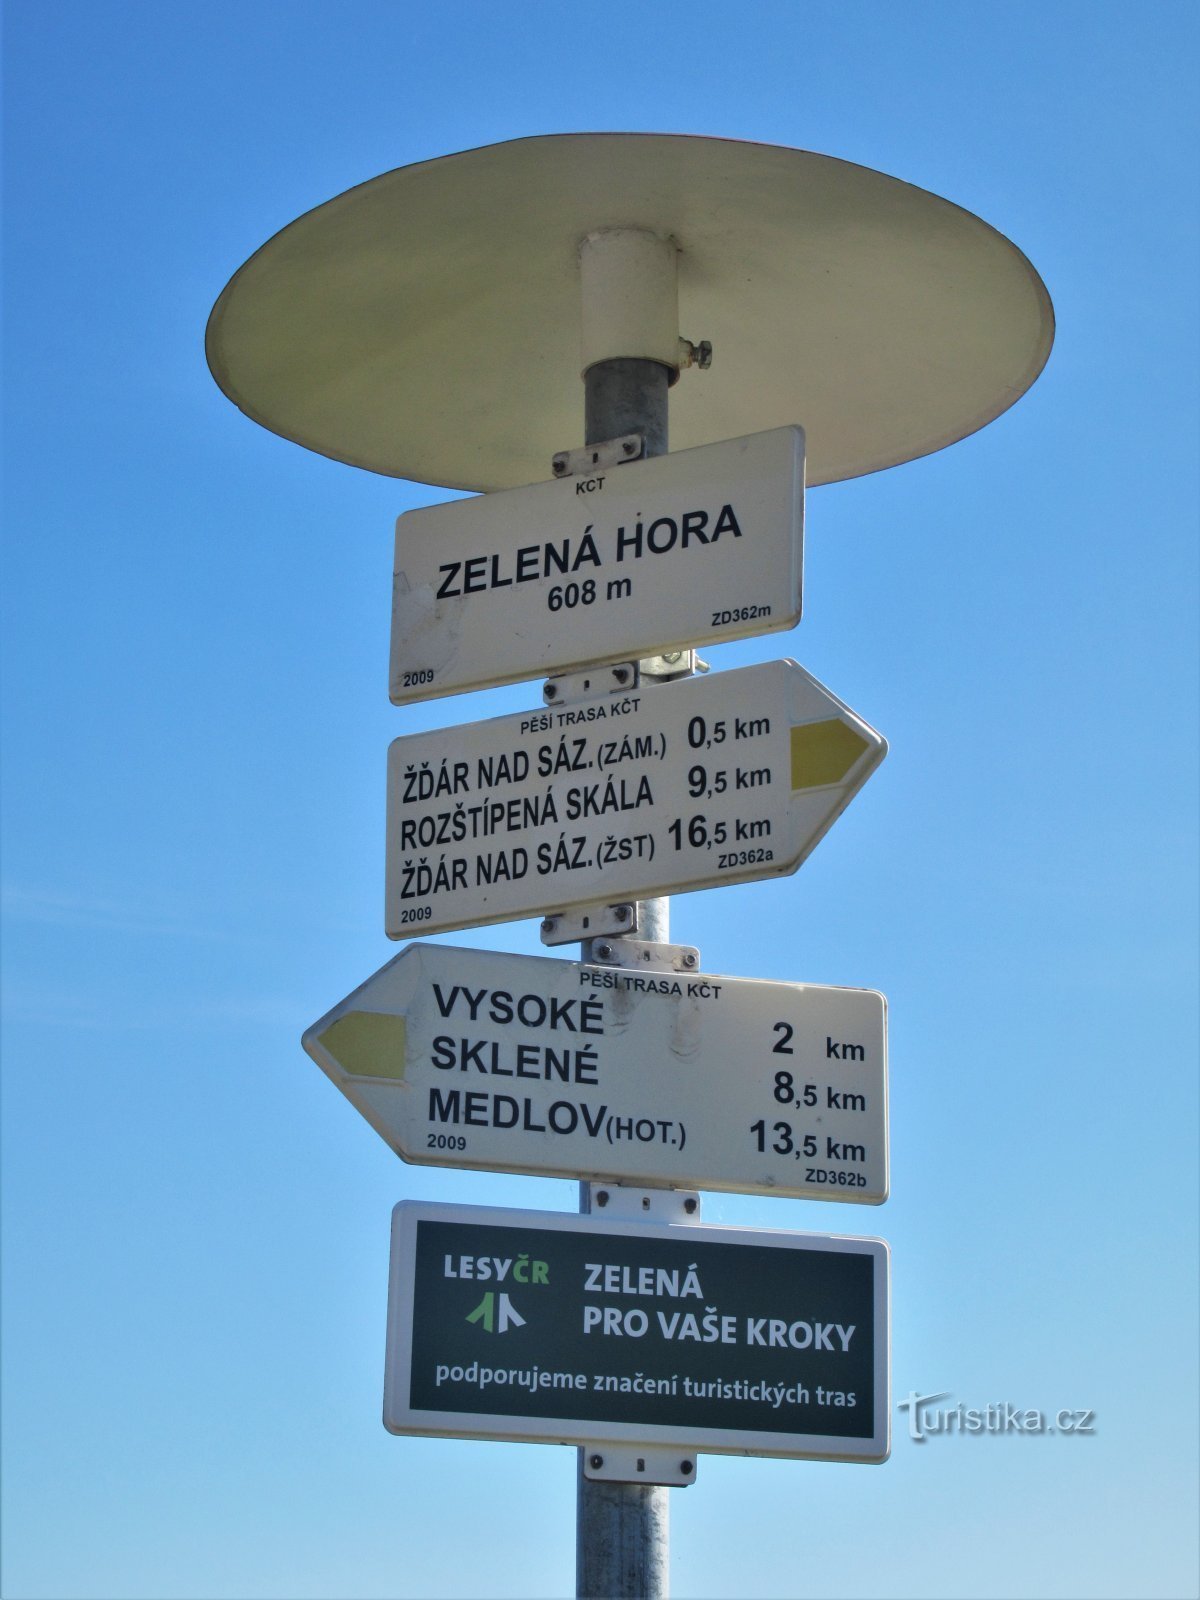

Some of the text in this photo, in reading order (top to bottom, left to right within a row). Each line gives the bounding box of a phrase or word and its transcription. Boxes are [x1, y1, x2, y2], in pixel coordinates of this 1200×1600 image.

[436, 504, 742, 599] ZELENÁ HORA
[547, 577, 632, 612] 608 m
[711, 603, 771, 627] ZD362m
[403, 670, 434, 687] 2009
[521, 698, 640, 734] PĚŠÍ TRASA KČT
[403, 758, 470, 803] ŽĎÁR
[478, 750, 529, 789] NAD
[688, 716, 726, 749] 0,5
[735, 718, 770, 740] km
[401, 765, 771, 851] ROZŠTÍPENÁ SKÁLA 9,5 km
[401, 854, 468, 899] ŽĎÁR
[476, 847, 528, 886] NAD
[668, 815, 727, 850] 16,5
[736, 819, 771, 841] km
[718, 849, 773, 869] ZD362a
[401, 906, 432, 923] 2009
[580, 971, 722, 999] PĚŠÍ TRASA KČT
[432, 983, 865, 1061] VYSOKÉ 2 km
[431, 1036, 866, 1111] SKLENÉ 8,5 km
[427, 1134, 466, 1150] 2009
[750, 1120, 817, 1160] 13,5
[827, 1137, 865, 1162] km
[805, 1168, 867, 1187] ZD362b
[584, 1263, 703, 1300] ZELENÁ
[583, 1306, 856, 1353] PRO VAŠE KROKY
[436, 1361, 856, 1408] podporujeme značení turistických tras
